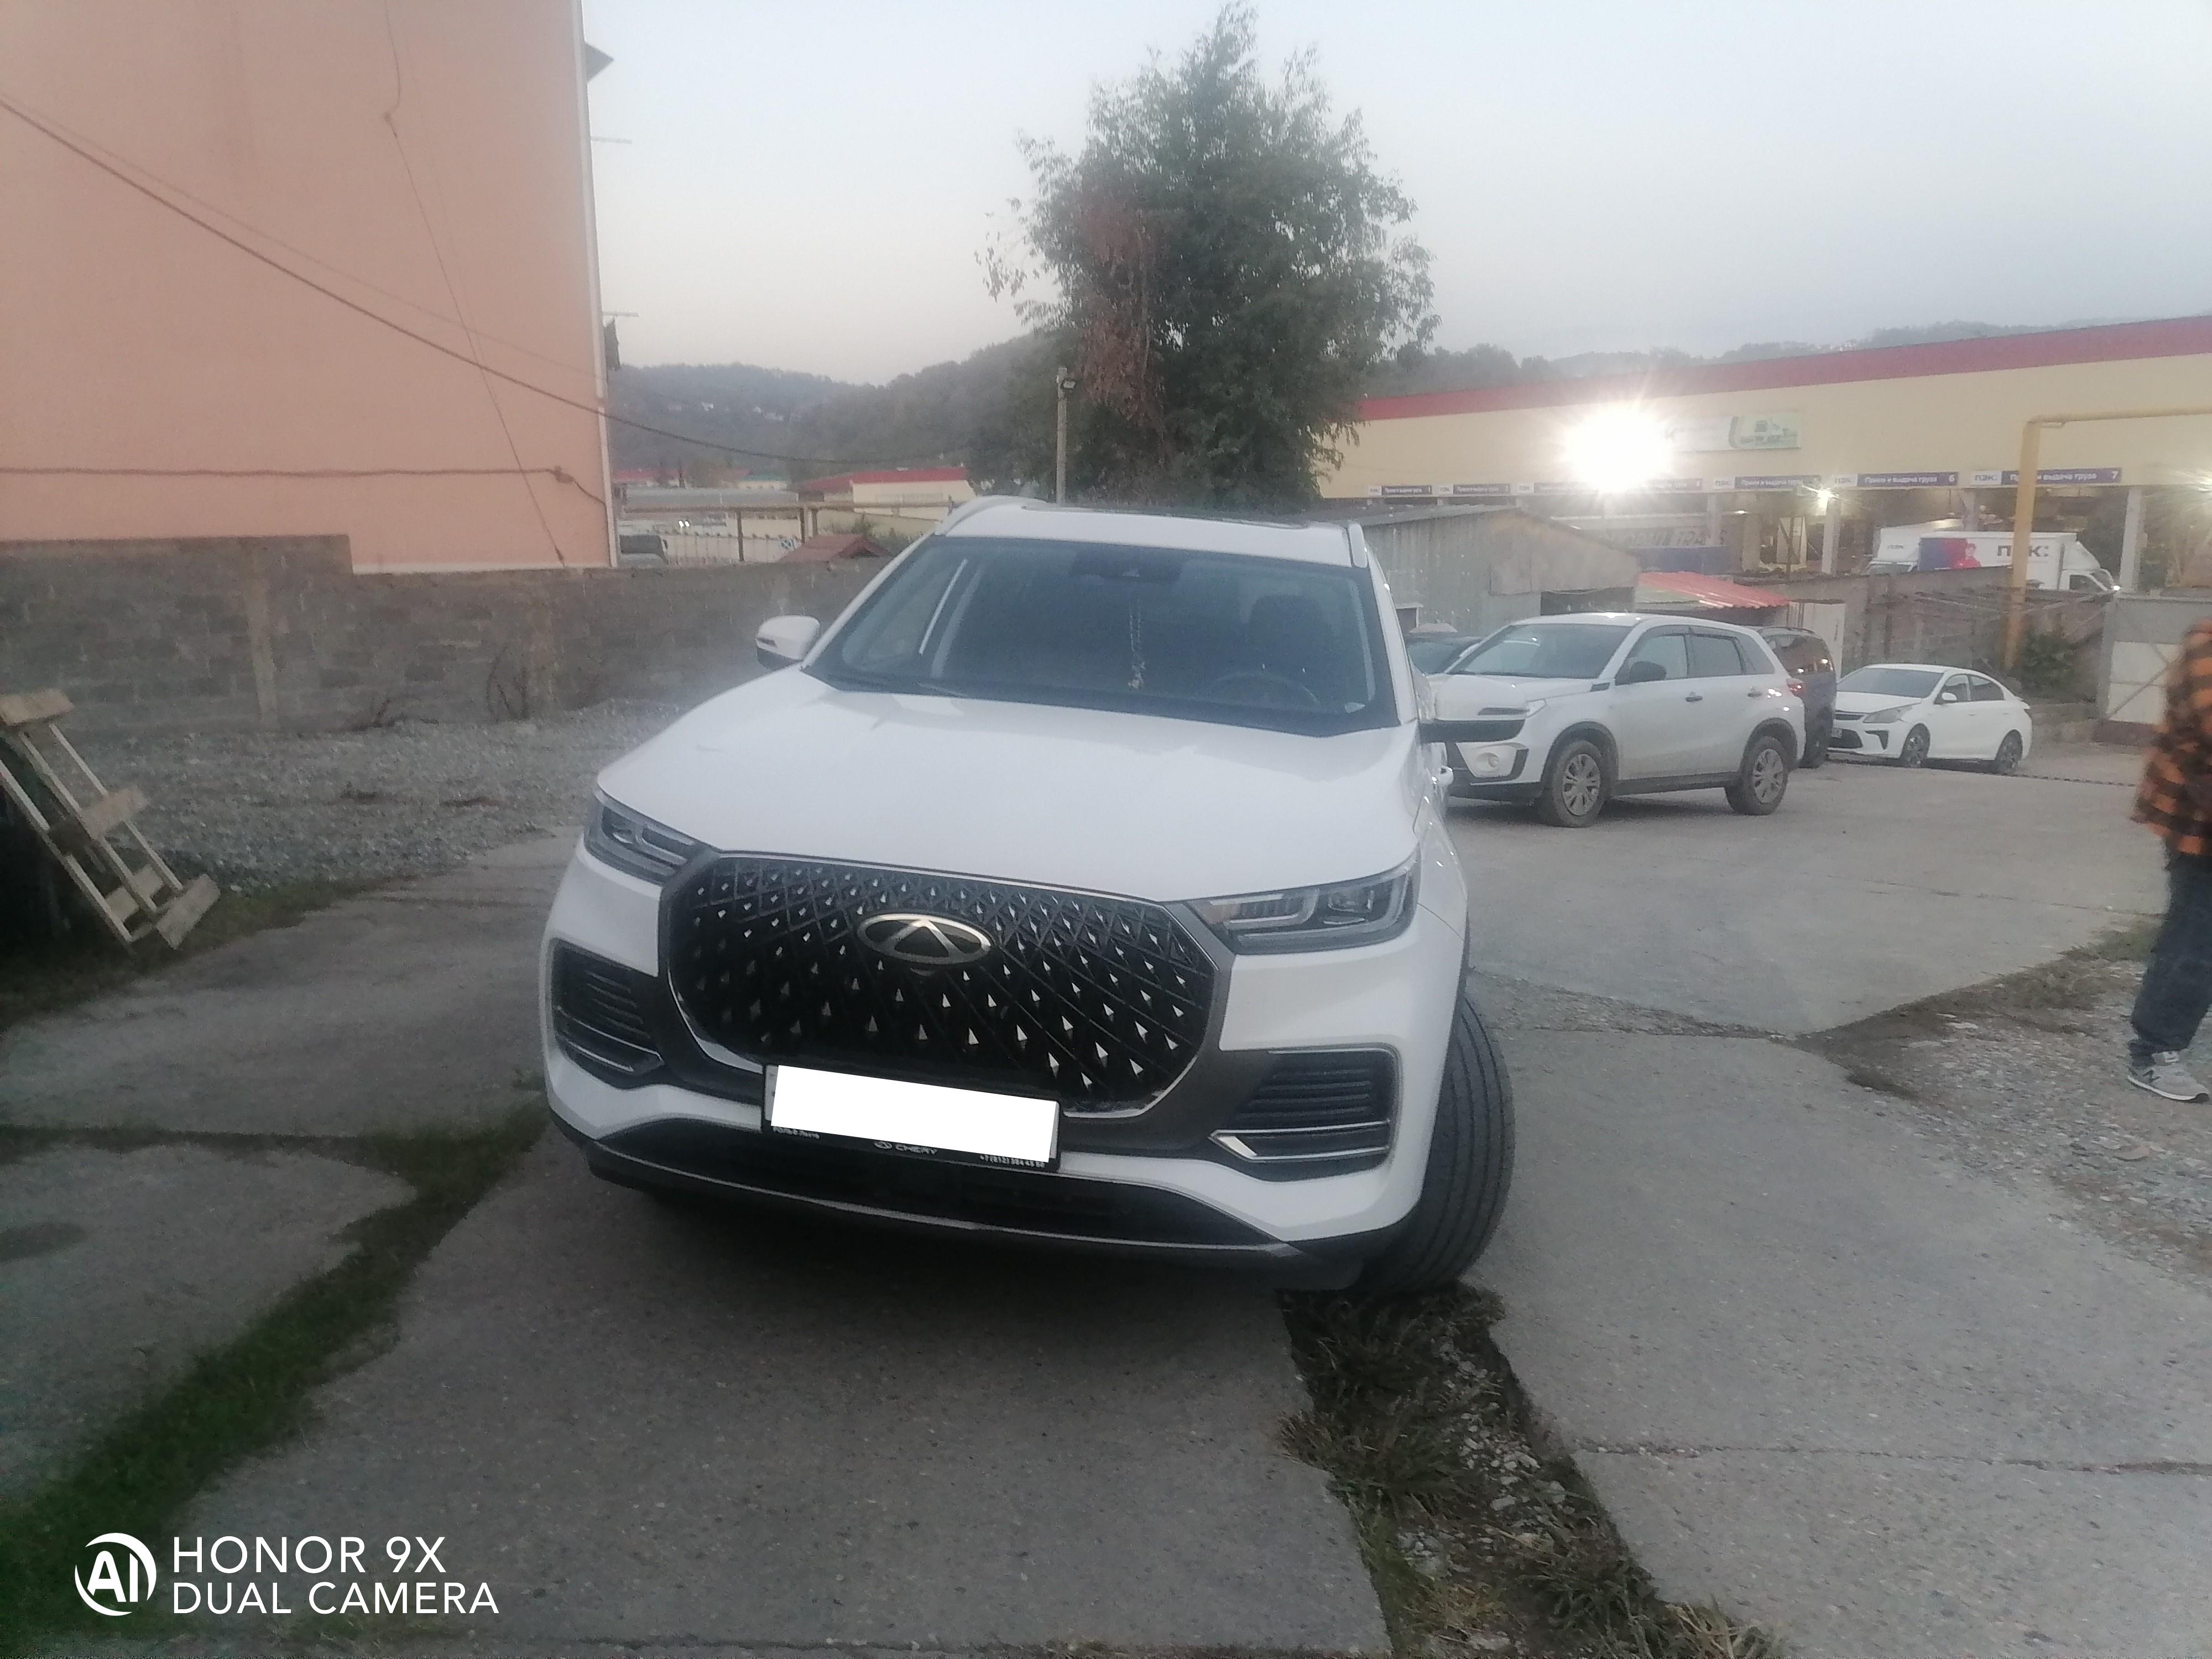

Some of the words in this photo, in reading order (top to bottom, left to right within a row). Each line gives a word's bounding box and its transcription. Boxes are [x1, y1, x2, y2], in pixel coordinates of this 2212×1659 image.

[1948, 474, 1956, 482] 6
[2111, 471, 2119, 479] 7
[1997, 545, 2049, 557] ПК:
[895, 1143, 938, 1155] CHERY
